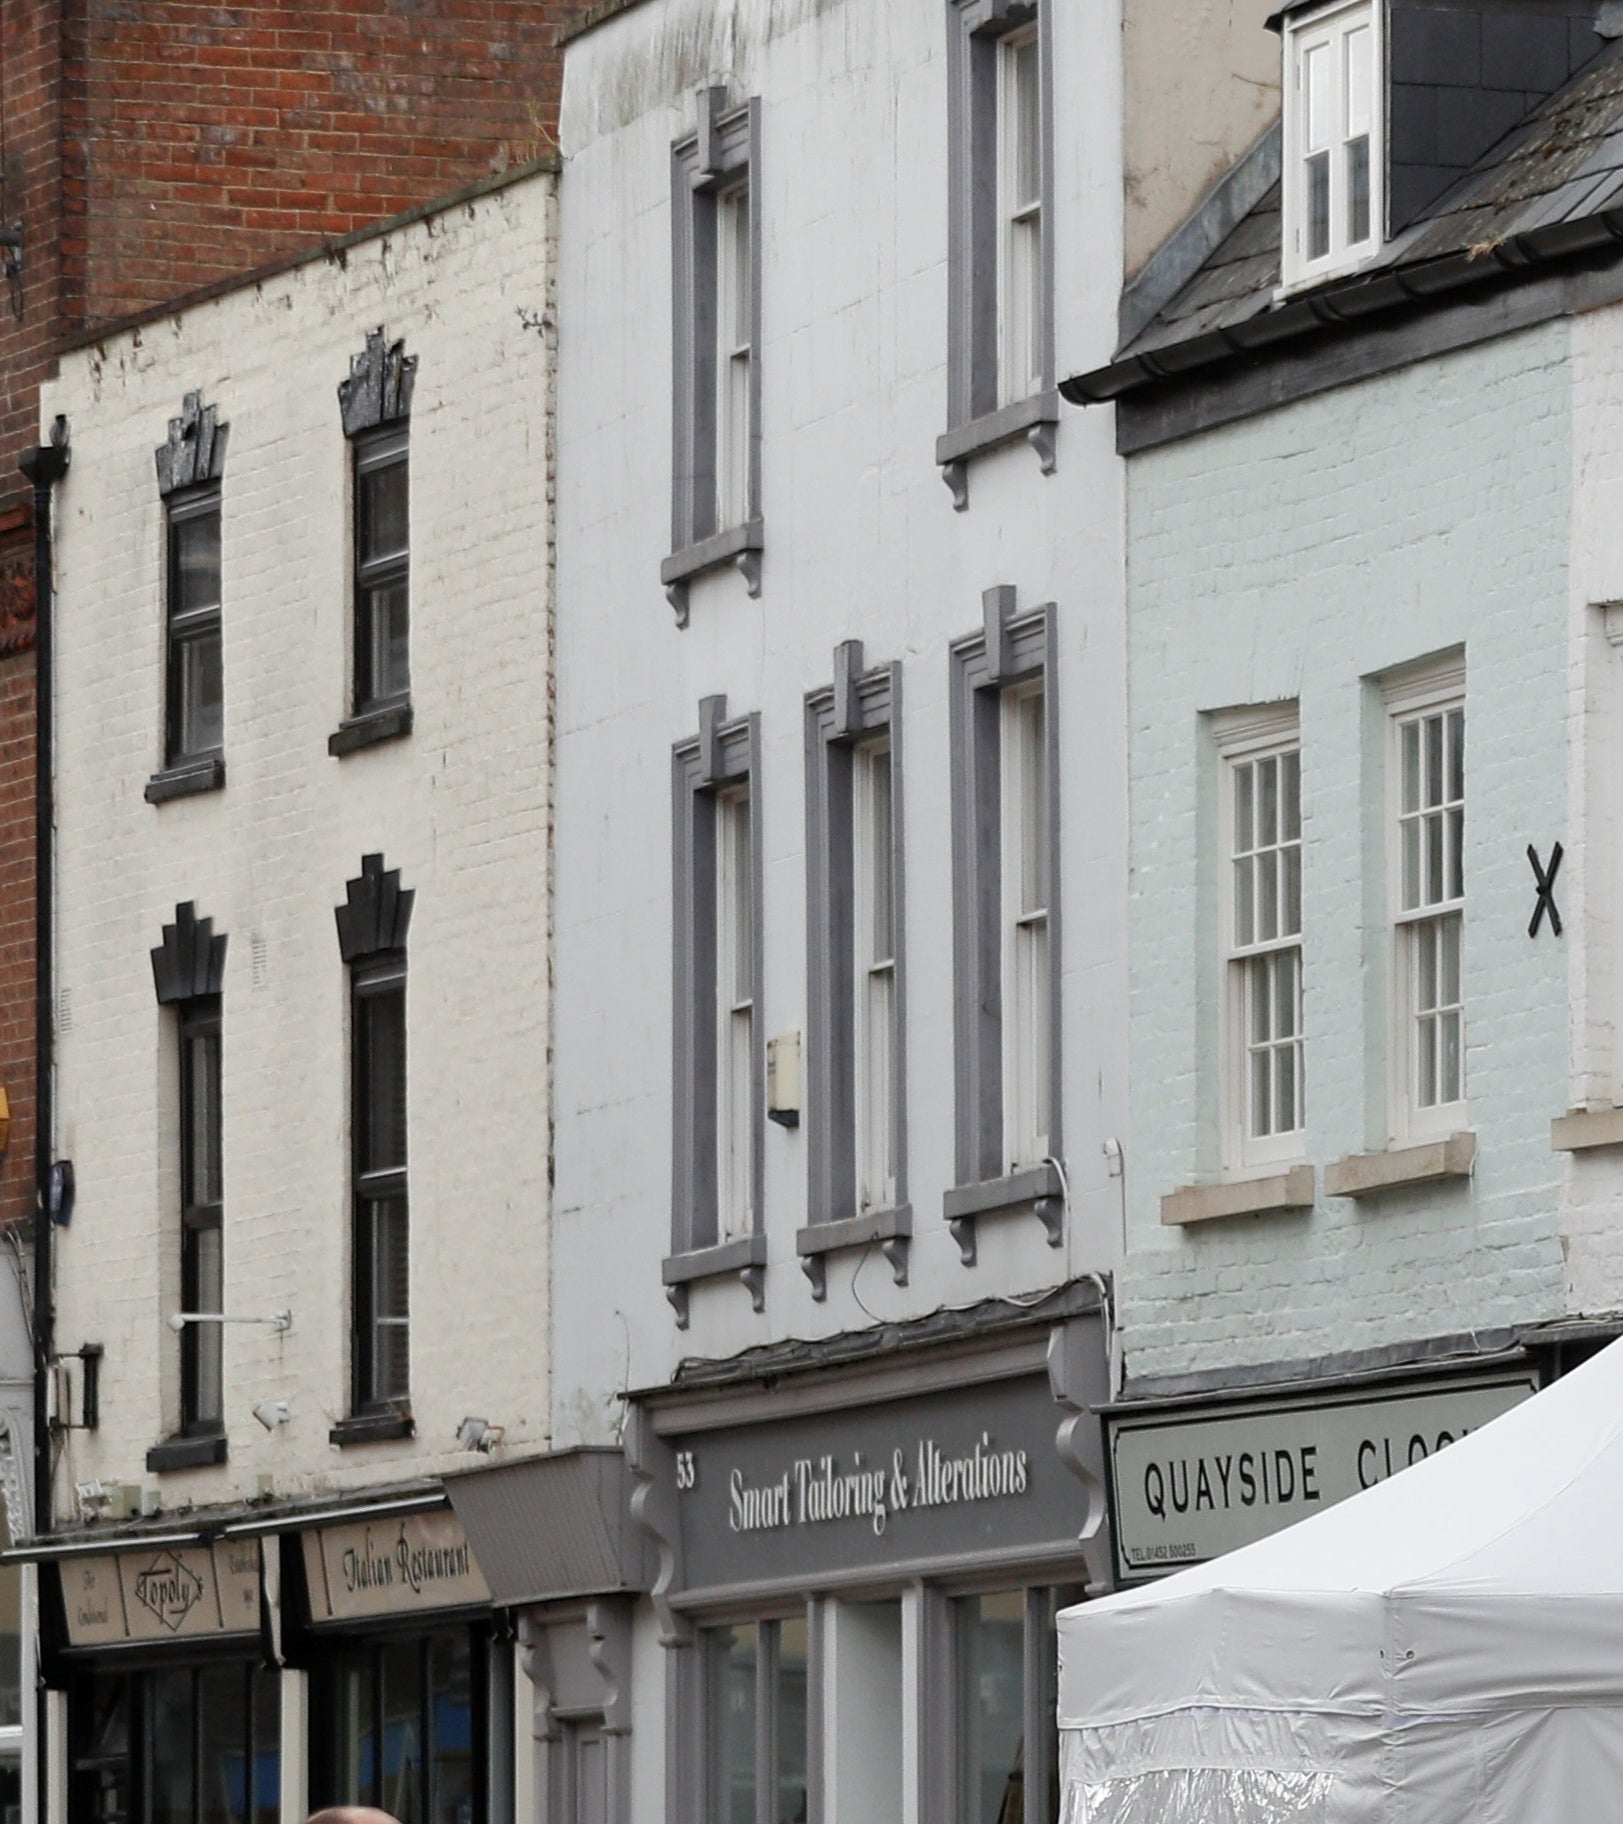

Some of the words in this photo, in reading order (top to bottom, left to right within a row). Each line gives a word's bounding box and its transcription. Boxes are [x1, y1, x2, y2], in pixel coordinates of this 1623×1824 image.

[676, 1452, 695, 1489] 53
[730, 1468, 791, 1533] Smart
[794, 1451, 887, 1536] Tailoring
[890, 1447, 908, 1510] &
[912, 1431, 1027, 1507] Alterations
[1144, 1446, 1321, 1522] QUAYSIDE
[343, 1526, 394, 1593] Italian
[395, 1521, 471, 1594] Restaurant
